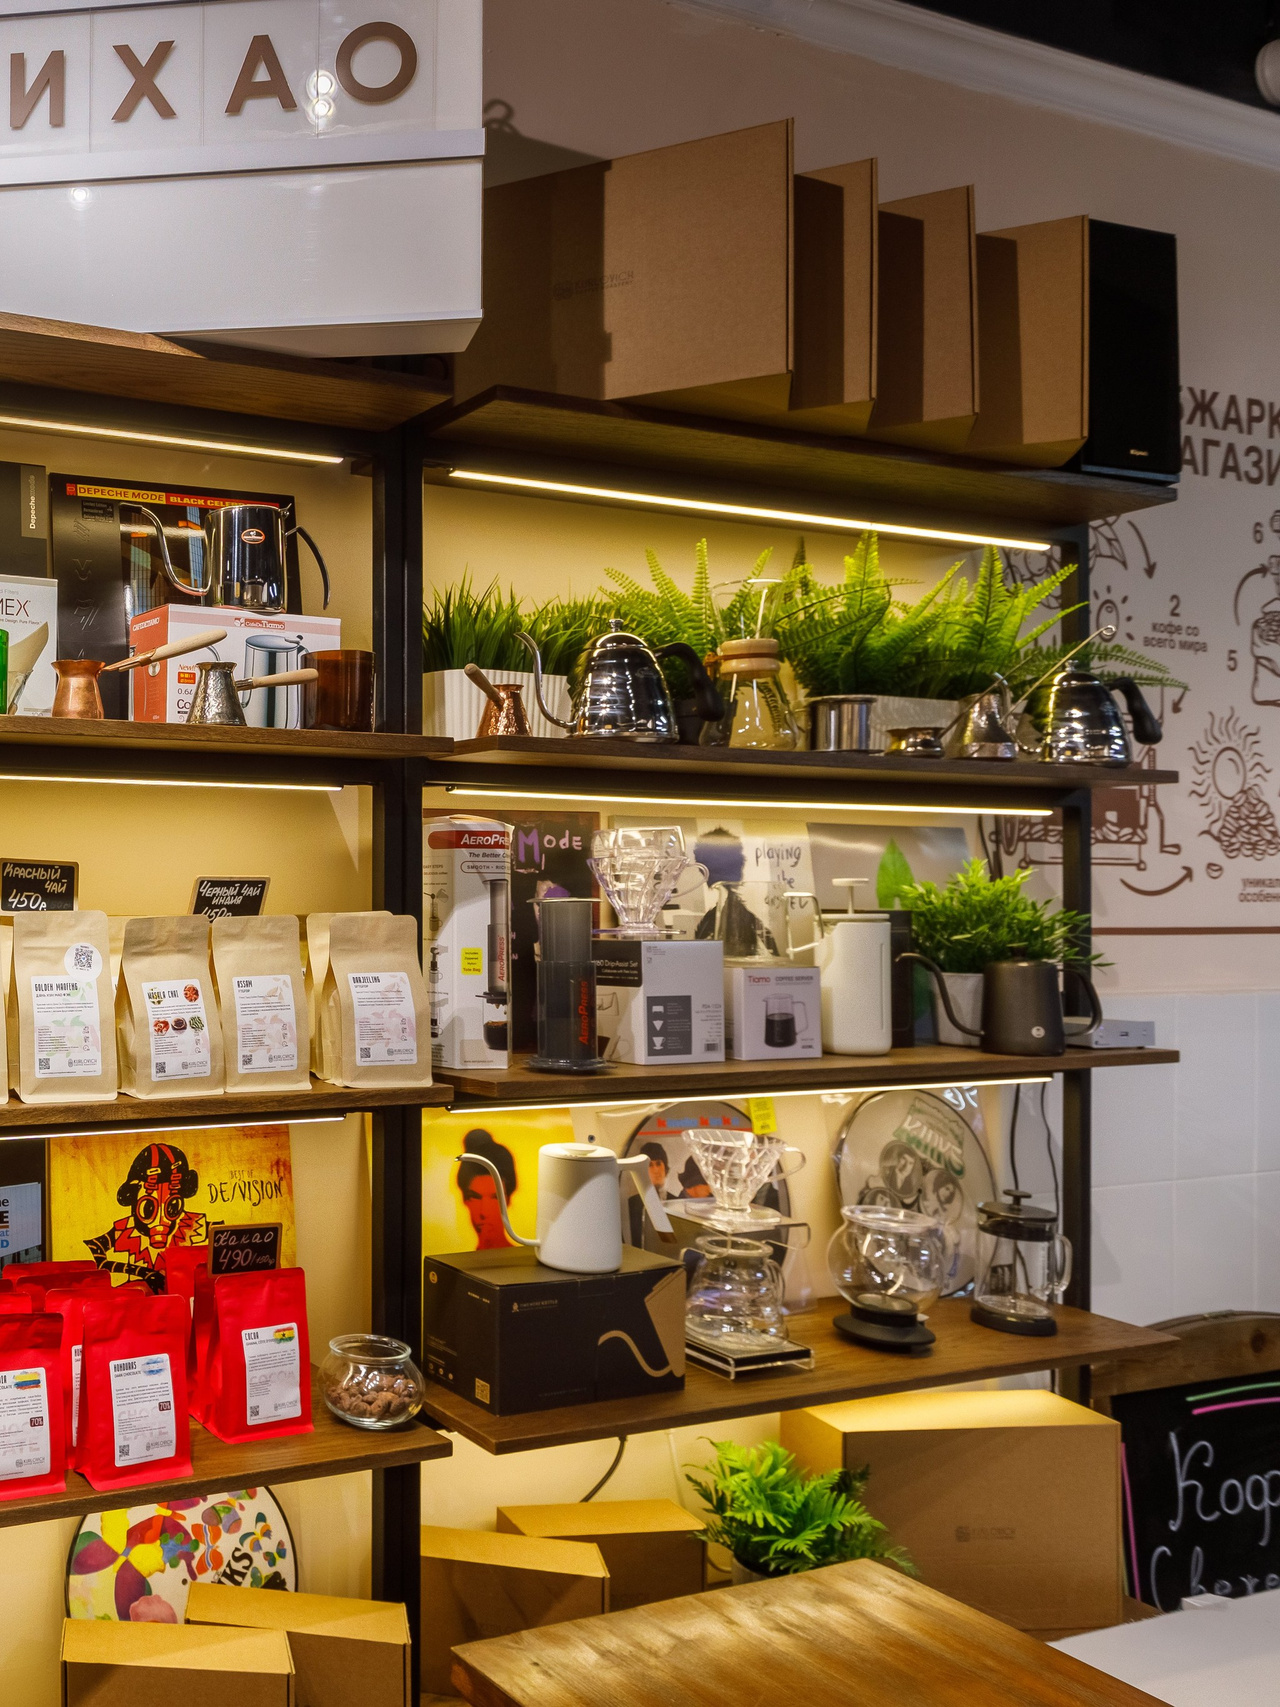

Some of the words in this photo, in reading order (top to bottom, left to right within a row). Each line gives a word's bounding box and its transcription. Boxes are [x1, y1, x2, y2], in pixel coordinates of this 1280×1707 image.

[78, 486, 130, 499] DEPECHE
[131, 492, 164, 502] MODE
[170, 496, 205, 506] BLACK
[1253, 522, 1263, 544] 6
[1170, 594, 1180, 617] 2
[1152, 621, 1182, 637] кофе
[1185, 625, 1200, 636] со
[1143, 636, 1176, 649] всего
[1179, 639, 1208, 654] мира
[1227, 650, 1237, 671] 5
[3, 863, 61, 879] КРАСНЫЙ
[44, 879, 68, 893] ЧАЙ
[200, 881, 240, 897] ЧЕРНЫЙ
[241, 884, 263, 897] ЧАЙ
[211, 896, 244, 905] ИНДИЯ
[237, 979, 253, 988] ASSAM
[352, 976, 380, 984] DARJEELING
[748, 975, 771, 984] Tiamo
[34, 983, 54, 992] GOLDEN
[167, 990, 179, 999] CHAI
[578, 981, 589, 1045] AEROPRESS
[230, 1170, 245, 1180] BEST
[245, 1332, 259, 1341] COCOA
[114, 1361, 137, 1372] HONDURAS
[160, 1402, 171, 1411] 70%
[31, 1417, 43, 1426] 70%
